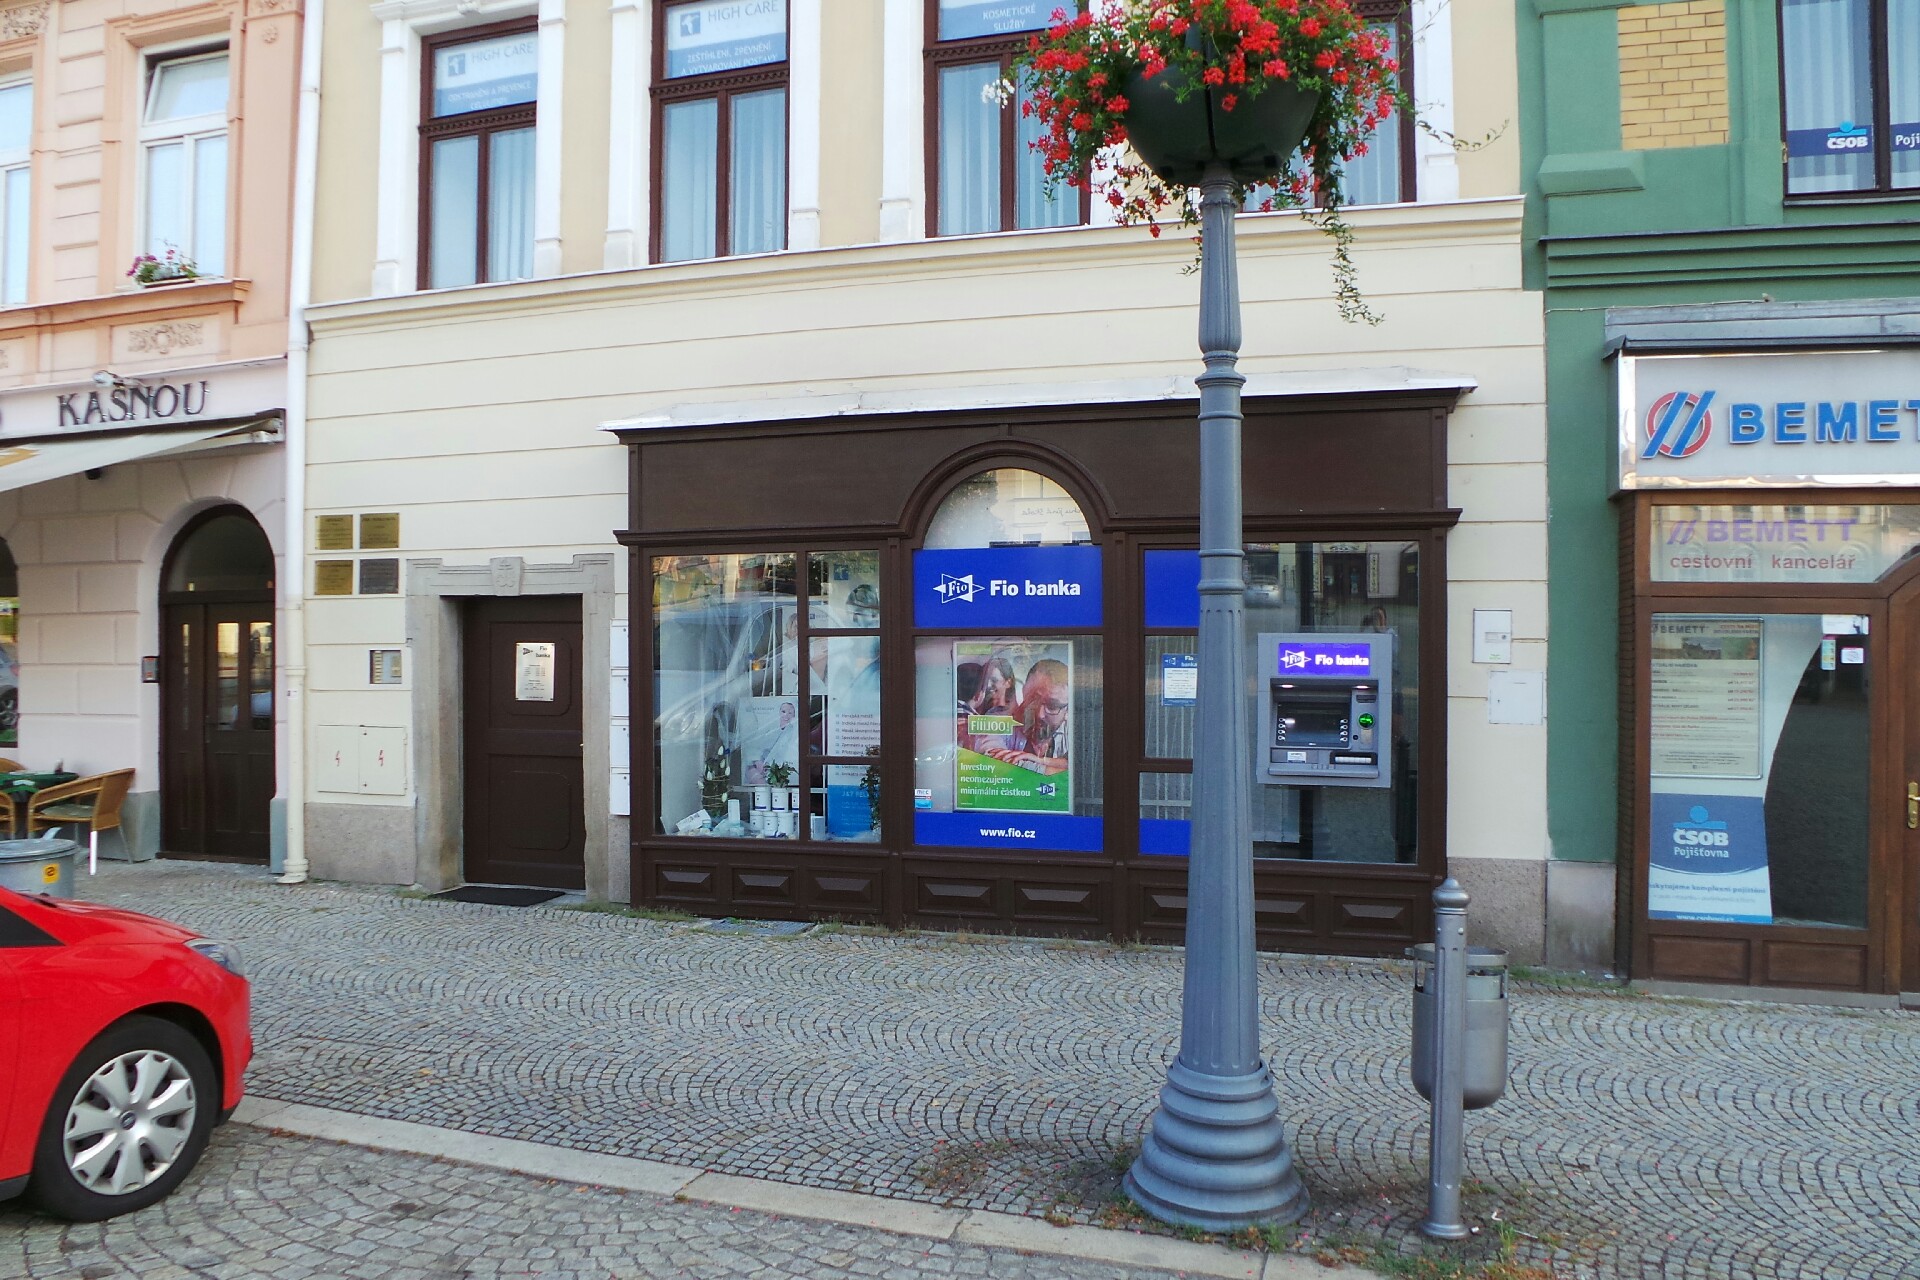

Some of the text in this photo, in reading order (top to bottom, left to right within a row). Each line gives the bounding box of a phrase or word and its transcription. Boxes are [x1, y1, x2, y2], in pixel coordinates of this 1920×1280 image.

[708, 1, 779, 22] HIGH CARE
[983, 3, 1036, 20] KOSMETICKÉ
[993, 19, 1025, 32] SLUŽBY
[471, 41, 534, 64] HIGH CARE
[1827, 136, 1868, 149] ČSOB
[1706, 518, 1858, 543] BEMETT
[1670, 553, 1856, 570] cestovní kancelář
[990, 579, 1019, 597] Fio
[1025, 579, 1081, 597] banka
[1315, 654, 1334, 666] Fio
[1336, 654, 1370, 666] banka
[960, 763, 995, 774] Investory
[960, 775, 1013, 786] neomezujeme
[960, 786, 1031, 798] minimální částkou
[980, 827, 1036, 839] www.fio.cz
[1673, 828, 1729, 846] ČSOB
[1674, 846, 1729, 859] Pojišťovna
